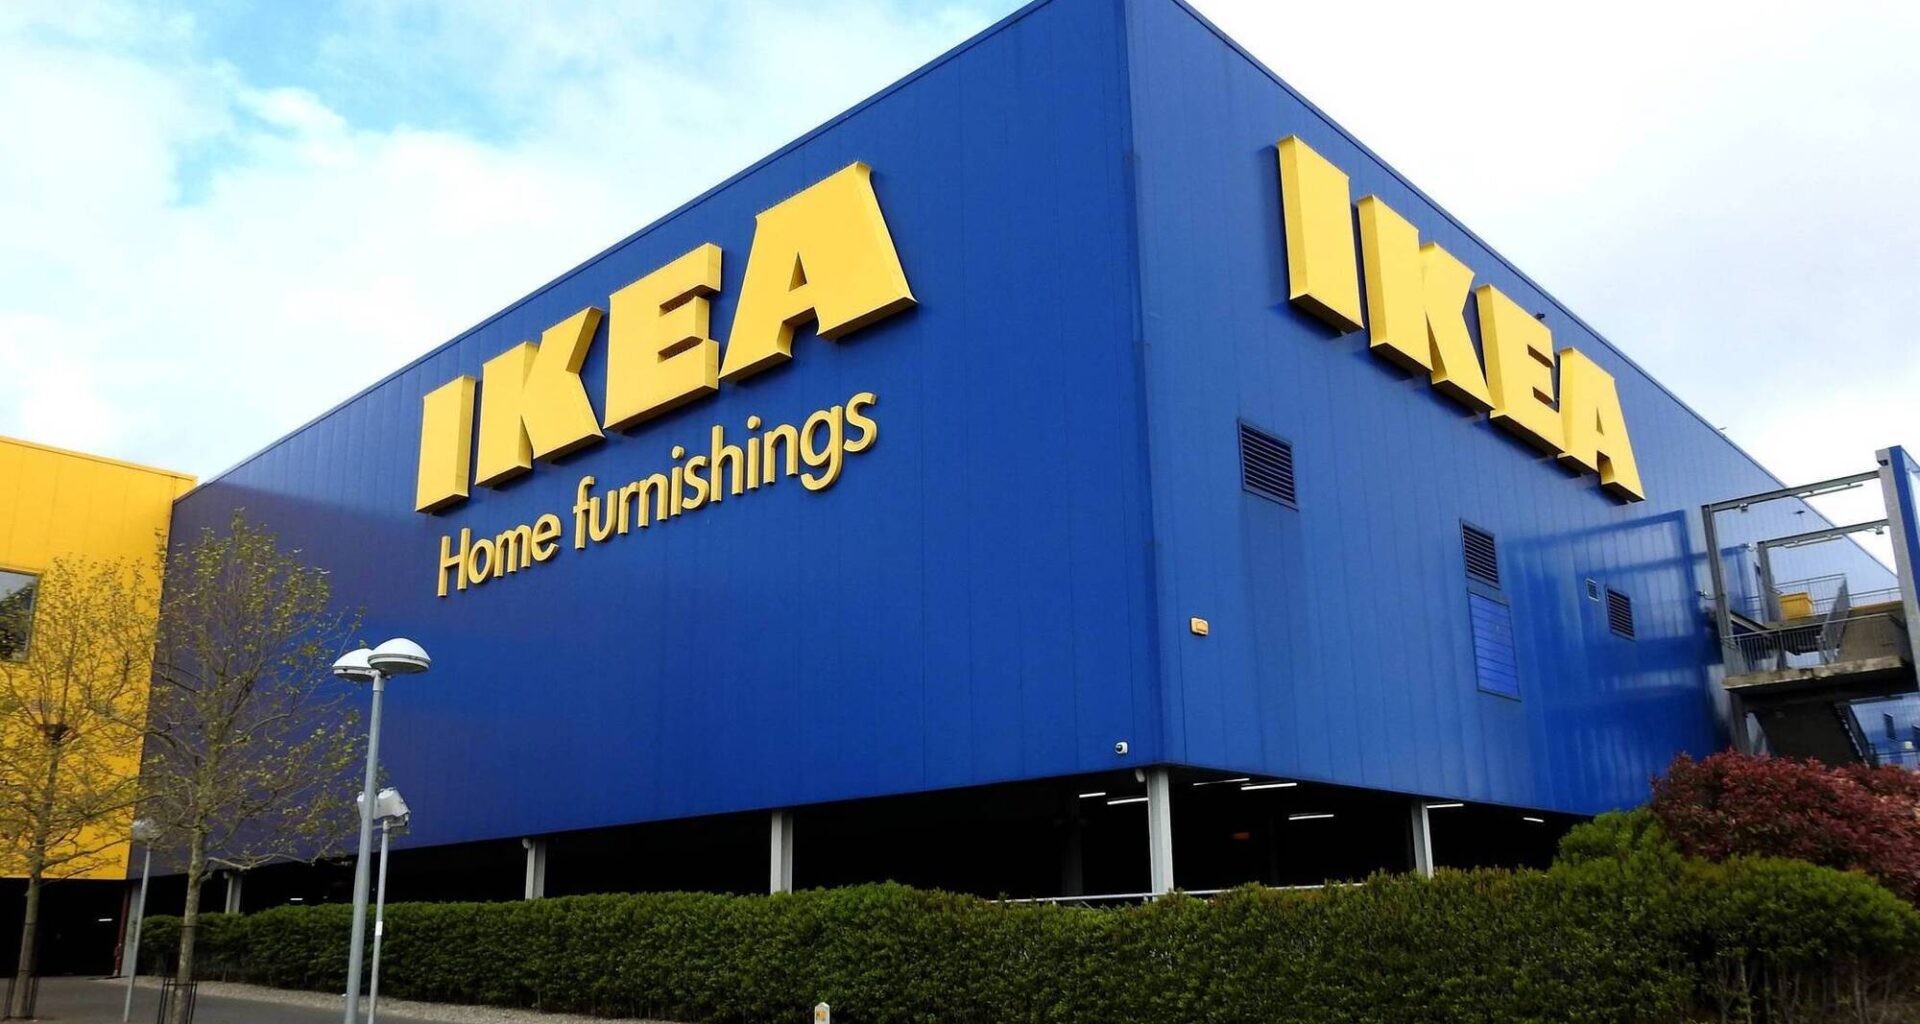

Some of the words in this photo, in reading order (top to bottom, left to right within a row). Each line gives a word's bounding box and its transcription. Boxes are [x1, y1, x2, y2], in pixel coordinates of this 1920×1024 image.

[415, 160, 918, 514] IKEA
[437, 512, 562, 597] Home
[573, 391, 879, 550] furnishings
[1276, 134, 1647, 502] IKEA
